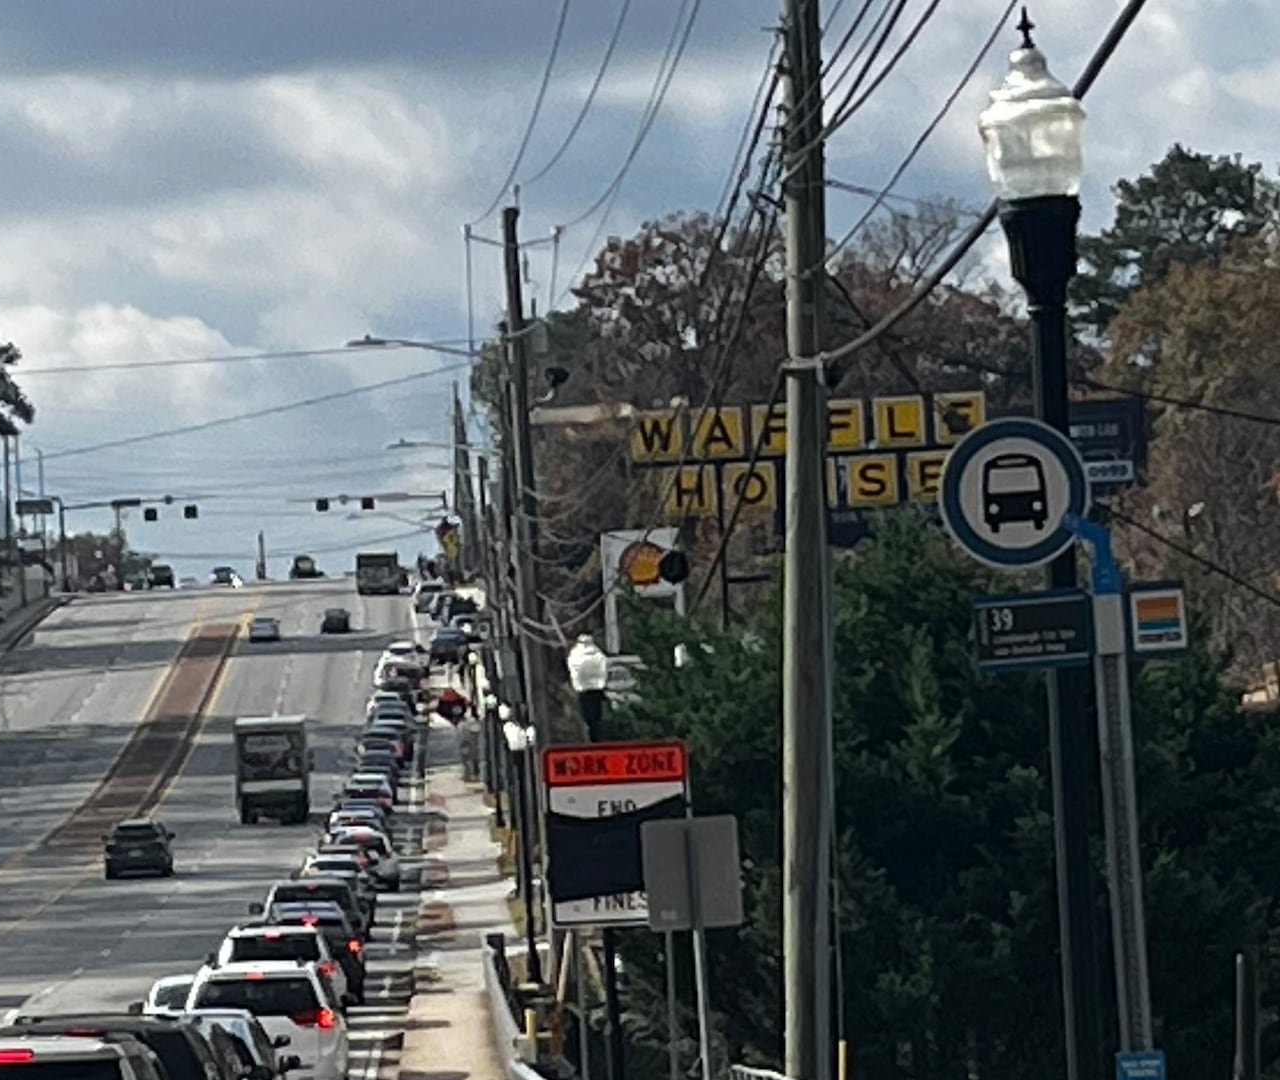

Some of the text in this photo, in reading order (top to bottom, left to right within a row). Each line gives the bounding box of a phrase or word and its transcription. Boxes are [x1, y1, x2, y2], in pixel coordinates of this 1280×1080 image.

[675, 459, 943, 508] HOSE
[990, 608, 1013, 631] 39
[554, 751, 676, 776] WORK ZONE
